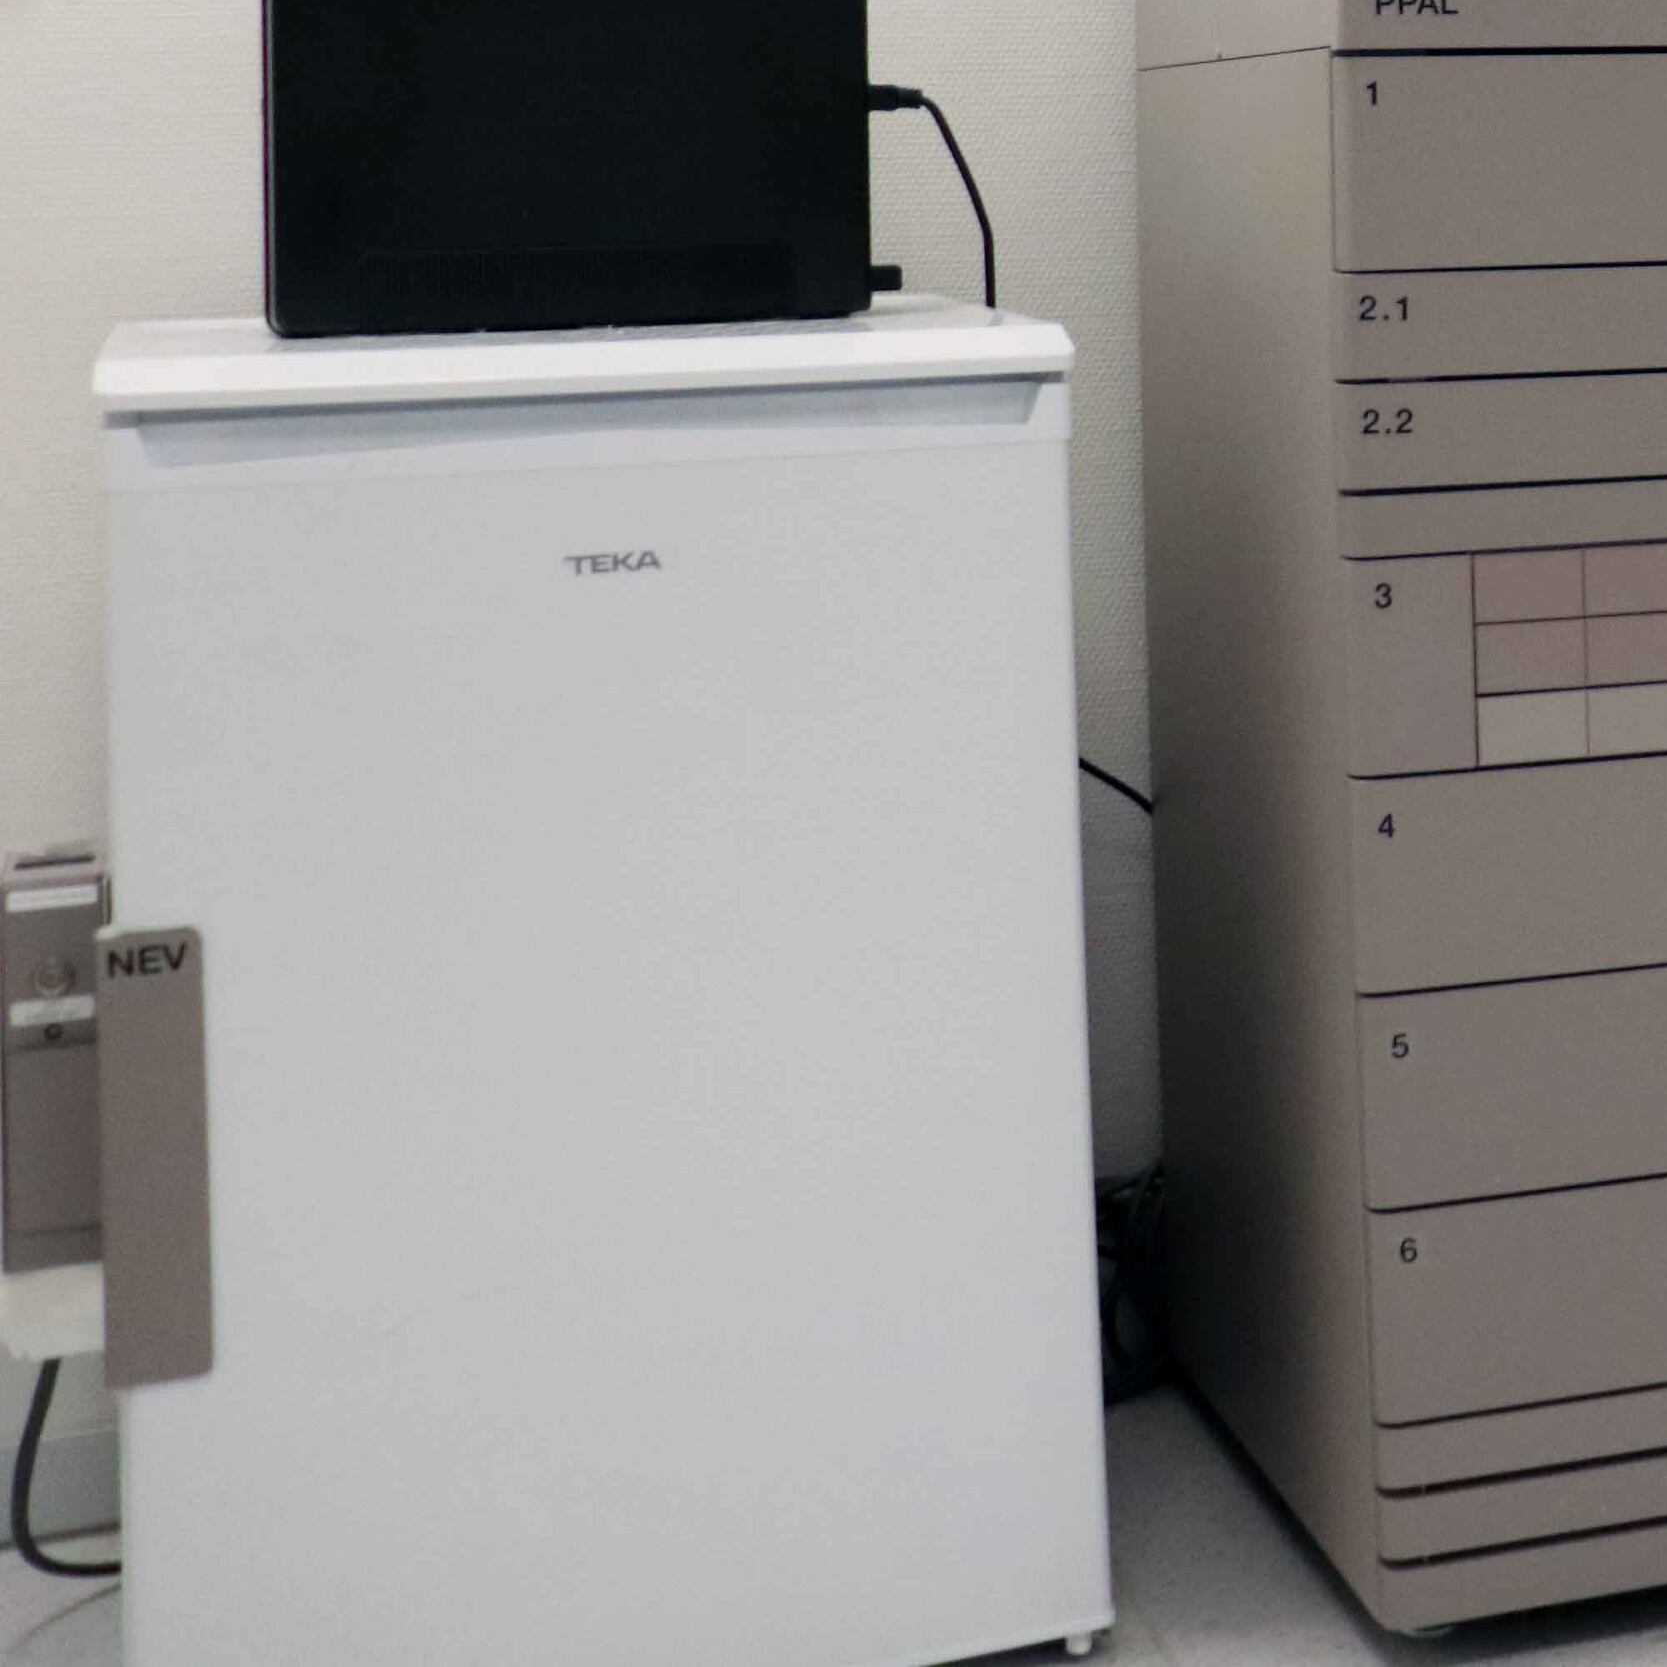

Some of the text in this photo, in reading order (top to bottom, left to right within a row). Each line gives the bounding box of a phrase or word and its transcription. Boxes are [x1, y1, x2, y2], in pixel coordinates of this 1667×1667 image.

[1366, 82, 1379, 106] 1
[1360, 296, 1410, 322] 2.1
[1361, 409, 1414, 435] 2.2
[563, 550, 662, 575] TEKA
[1374, 583, 1393, 609] 3
[1377, 814, 1396, 838] 4
[107, 942, 188, 980] NEV
[1391, 1034, 1409, 1059] 5
[1400, 1238, 1418, 1264] 6
